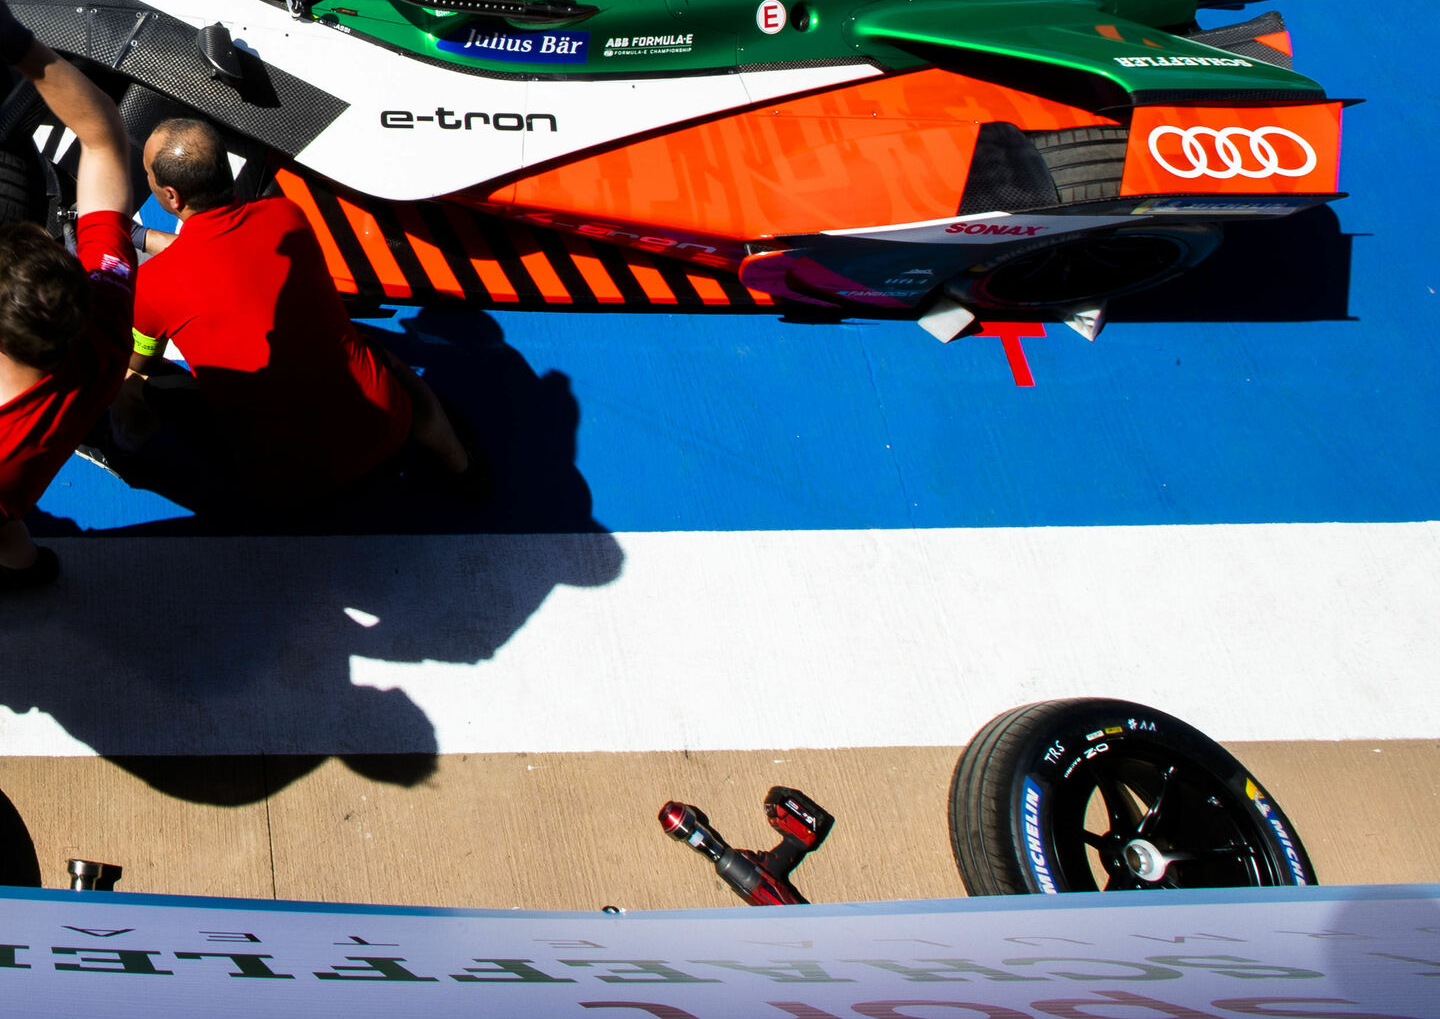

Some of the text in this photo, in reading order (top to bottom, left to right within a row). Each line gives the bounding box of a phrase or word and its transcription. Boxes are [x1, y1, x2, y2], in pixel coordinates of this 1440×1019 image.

[463, 27, 584, 56] Julius Bär
[605, 37, 629, 48] ABB
[649, 47, 692, 55] CHAMPIONSHIP
[1112, 56, 1254, 69] SCHAEFFLER
[380, 107, 558, 132] e-tron
[944, 222, 1043, 236] SONAX
[1024, 788, 1058, 895] MICHELIN
